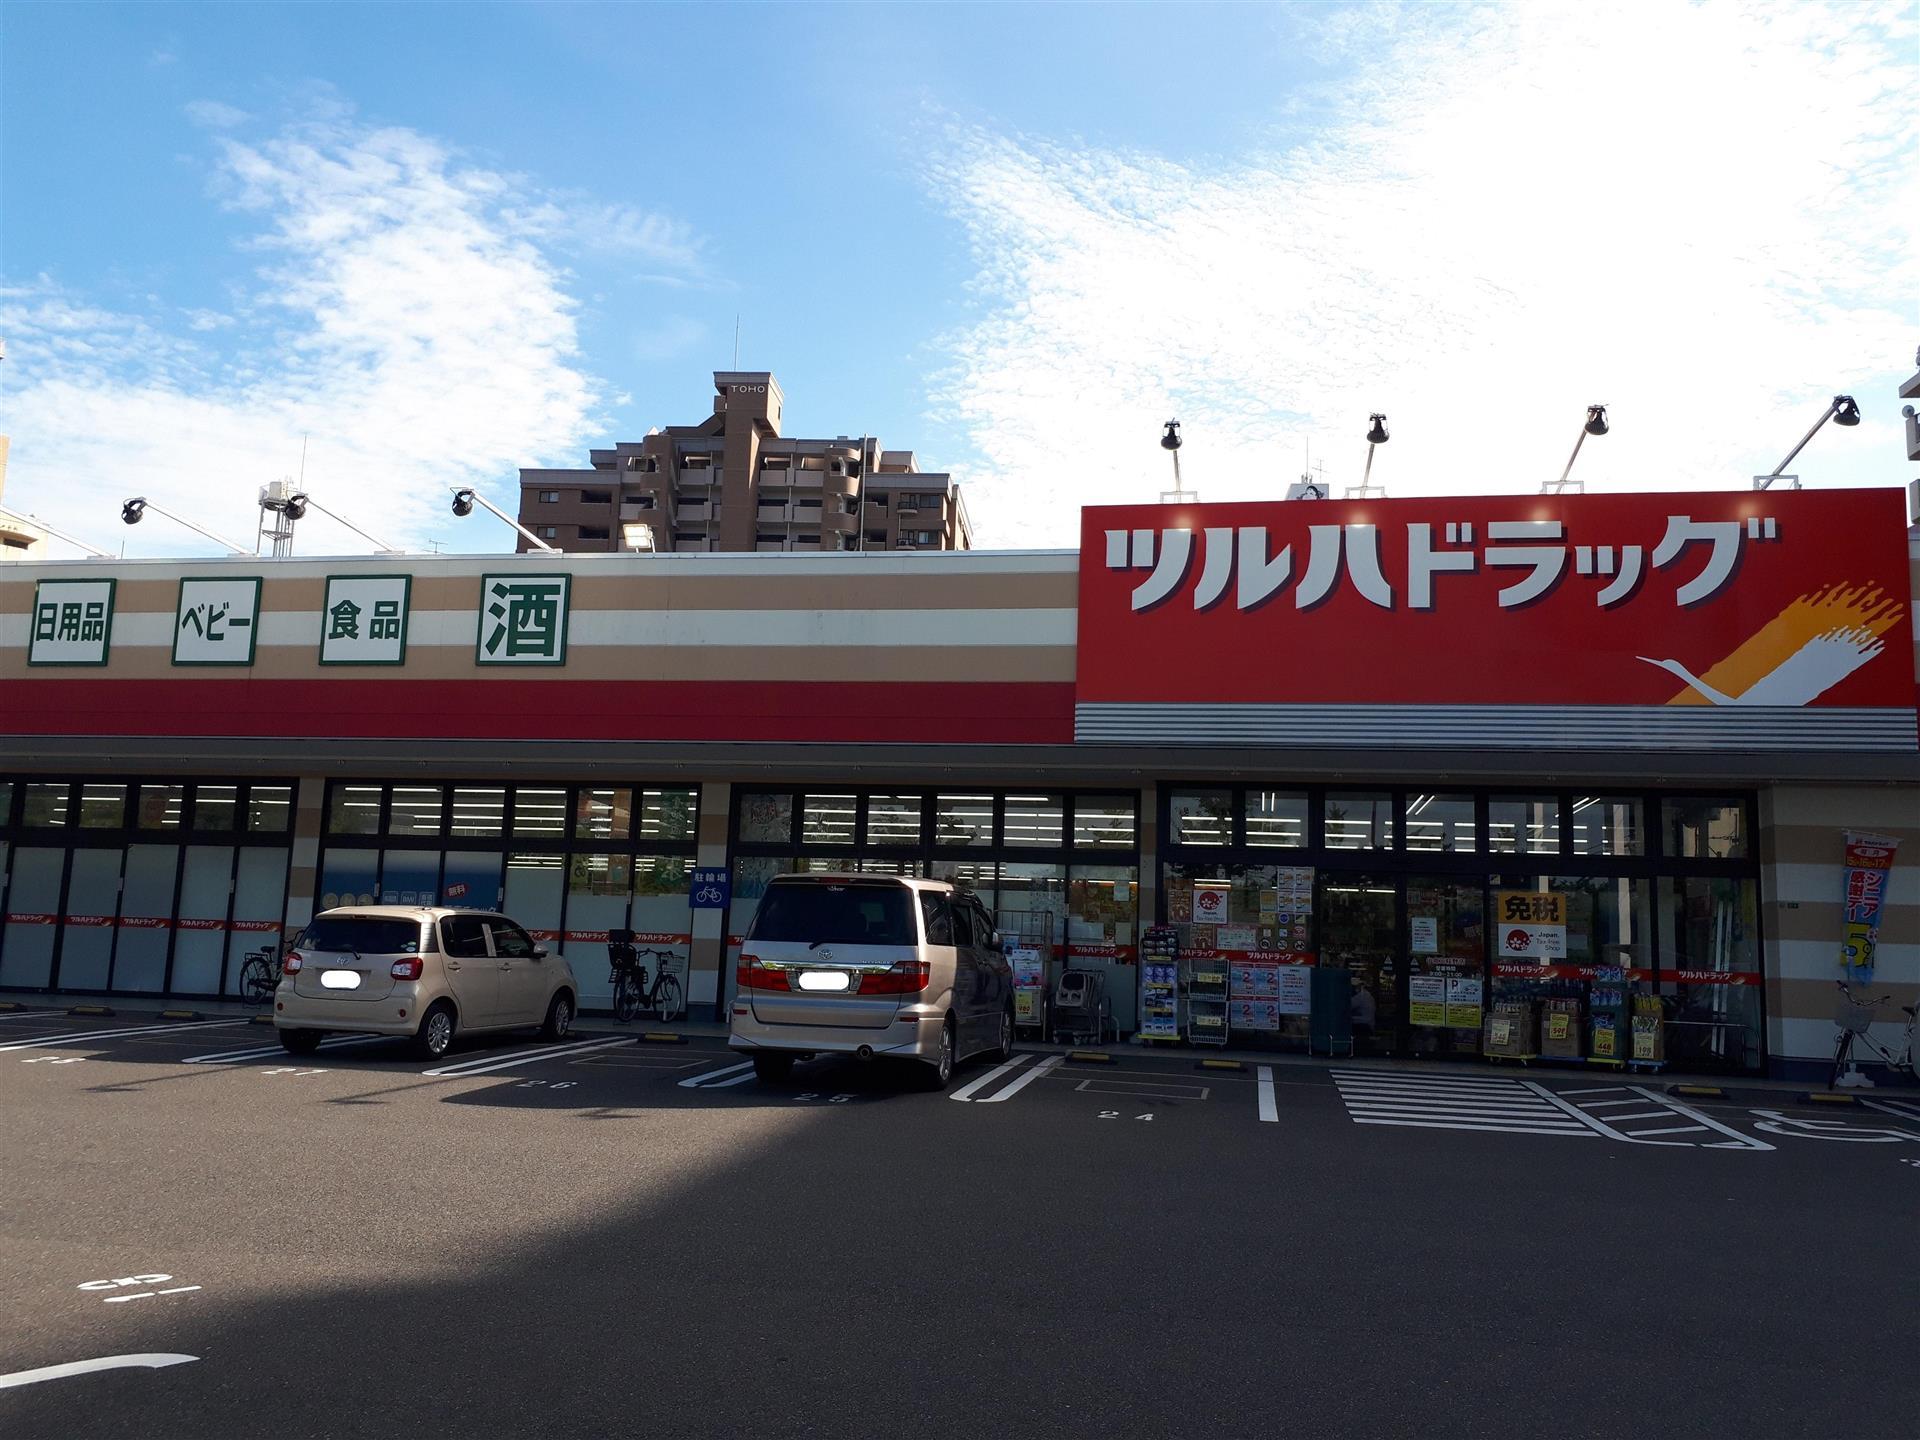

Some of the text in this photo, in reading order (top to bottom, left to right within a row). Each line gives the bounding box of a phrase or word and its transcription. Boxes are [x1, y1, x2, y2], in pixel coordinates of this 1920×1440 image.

[731, 385, 765, 393] TOHO
[1104, 515, 1776, 612] ツルハドラッグ
[35, 602, 104, 643] 日用品
[181, 601, 251, 642] ベビー
[328, 599, 400, 641] 食品
[485, 582, 561, 657] 酒
[1505, 895, 1559, 921] 免税
[1847, 870, 1866, 921] 感謝デー
[1863, 872, 1882, 917] シニア
[1075, 946, 1116, 954] ツルハドラッグ
[1246, 951, 1293, 961] ツルハドラッグ
[1498, 965, 1546, 975] ツルハドラッグ
[1679, 970, 1733, 980] ツルハドラッグ
